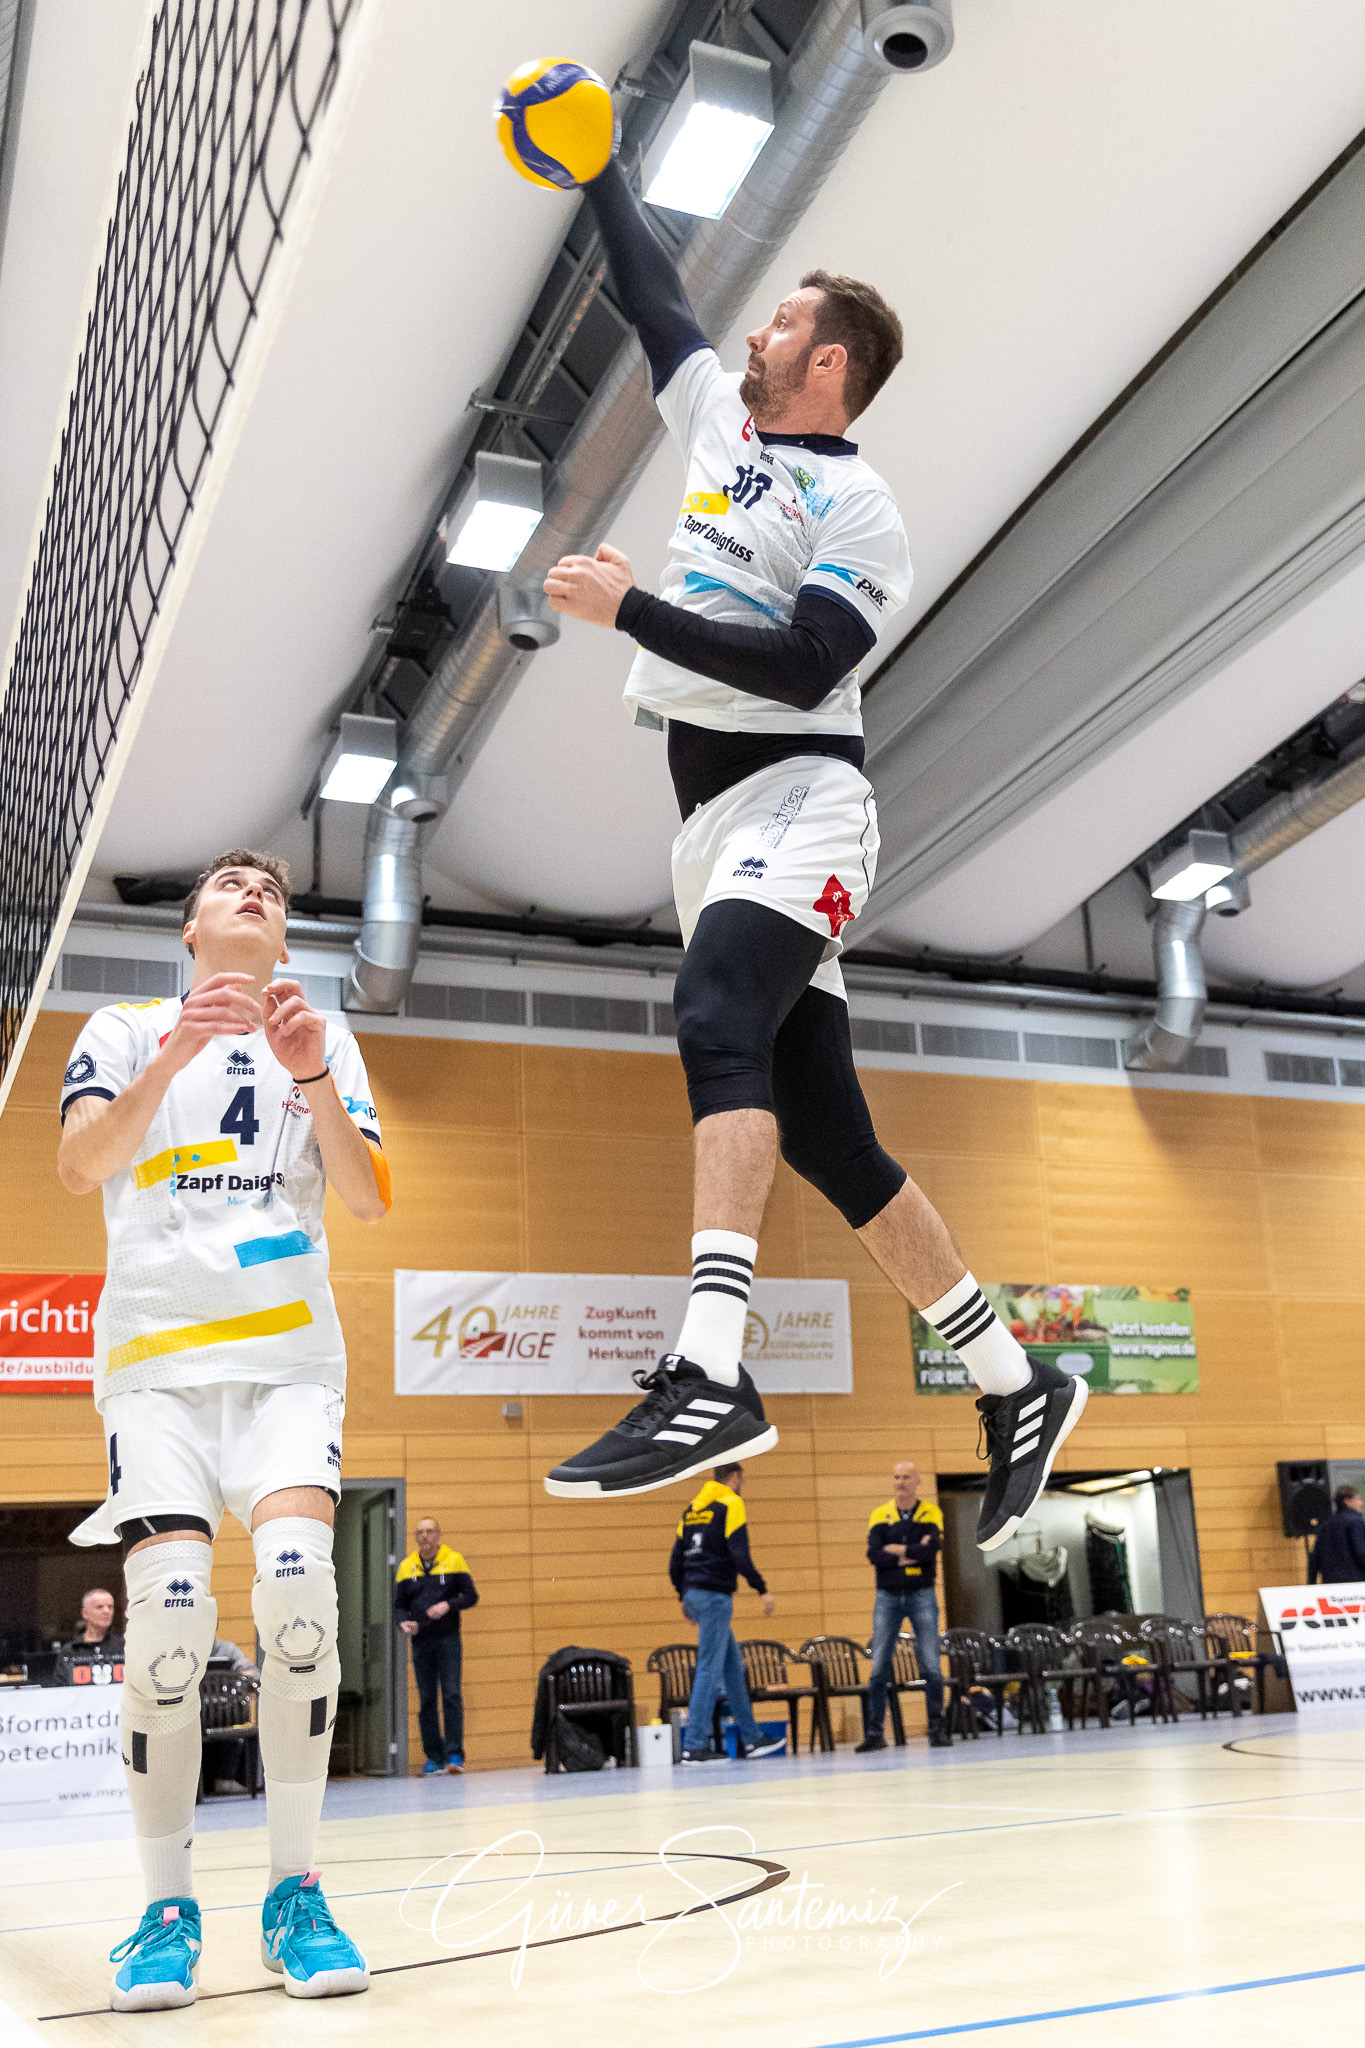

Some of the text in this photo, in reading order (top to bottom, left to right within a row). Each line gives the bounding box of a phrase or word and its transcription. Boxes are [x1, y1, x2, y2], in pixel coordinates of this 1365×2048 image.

[684, 514, 709, 536] Zapf
[704, 526, 755, 563] Daigfuss
[220, 1086, 259, 1145] 4
[176, 1174, 223, 1193] Zapf
[0, 1300, 95, 1333] richti
[586, 1306, 656, 1323] ZugKunft
[773, 1312, 834, 1332] JAHRE
[412, 1305, 560, 1358] 40 JAHRE
[578, 1325, 665, 1339] kommt von
[507, 1332, 557, 1358] IGE
[588, 1346, 656, 1360] Herkunft
[59, 1788, 129, 1801] www.mey
